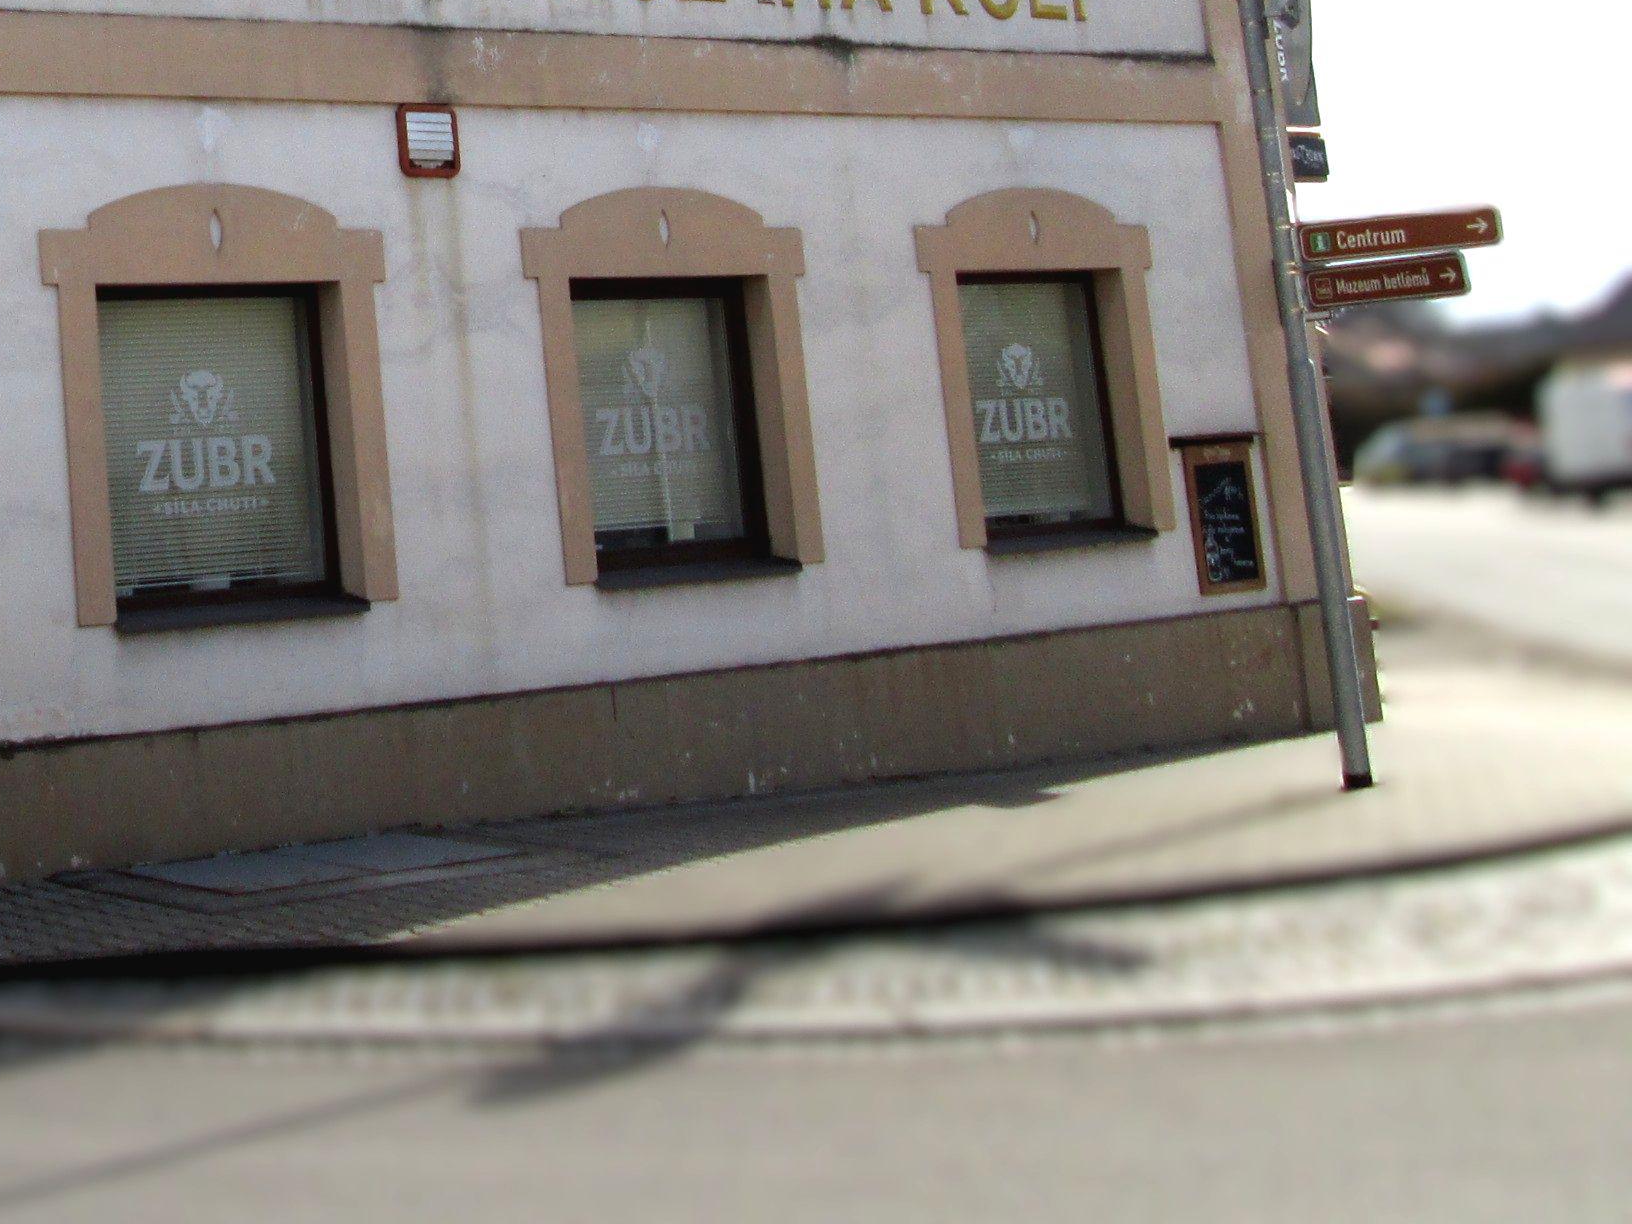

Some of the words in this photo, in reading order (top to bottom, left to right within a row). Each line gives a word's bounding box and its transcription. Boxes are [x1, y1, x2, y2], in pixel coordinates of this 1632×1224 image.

[1336, 228, 1407, 250] Centrum
[1335, 278, 1382, 295] Muzeum
[595, 404, 712, 457] ZUBR
[975, 397, 1074, 444] ZUBR
[136, 432, 278, 494] ZUBR
